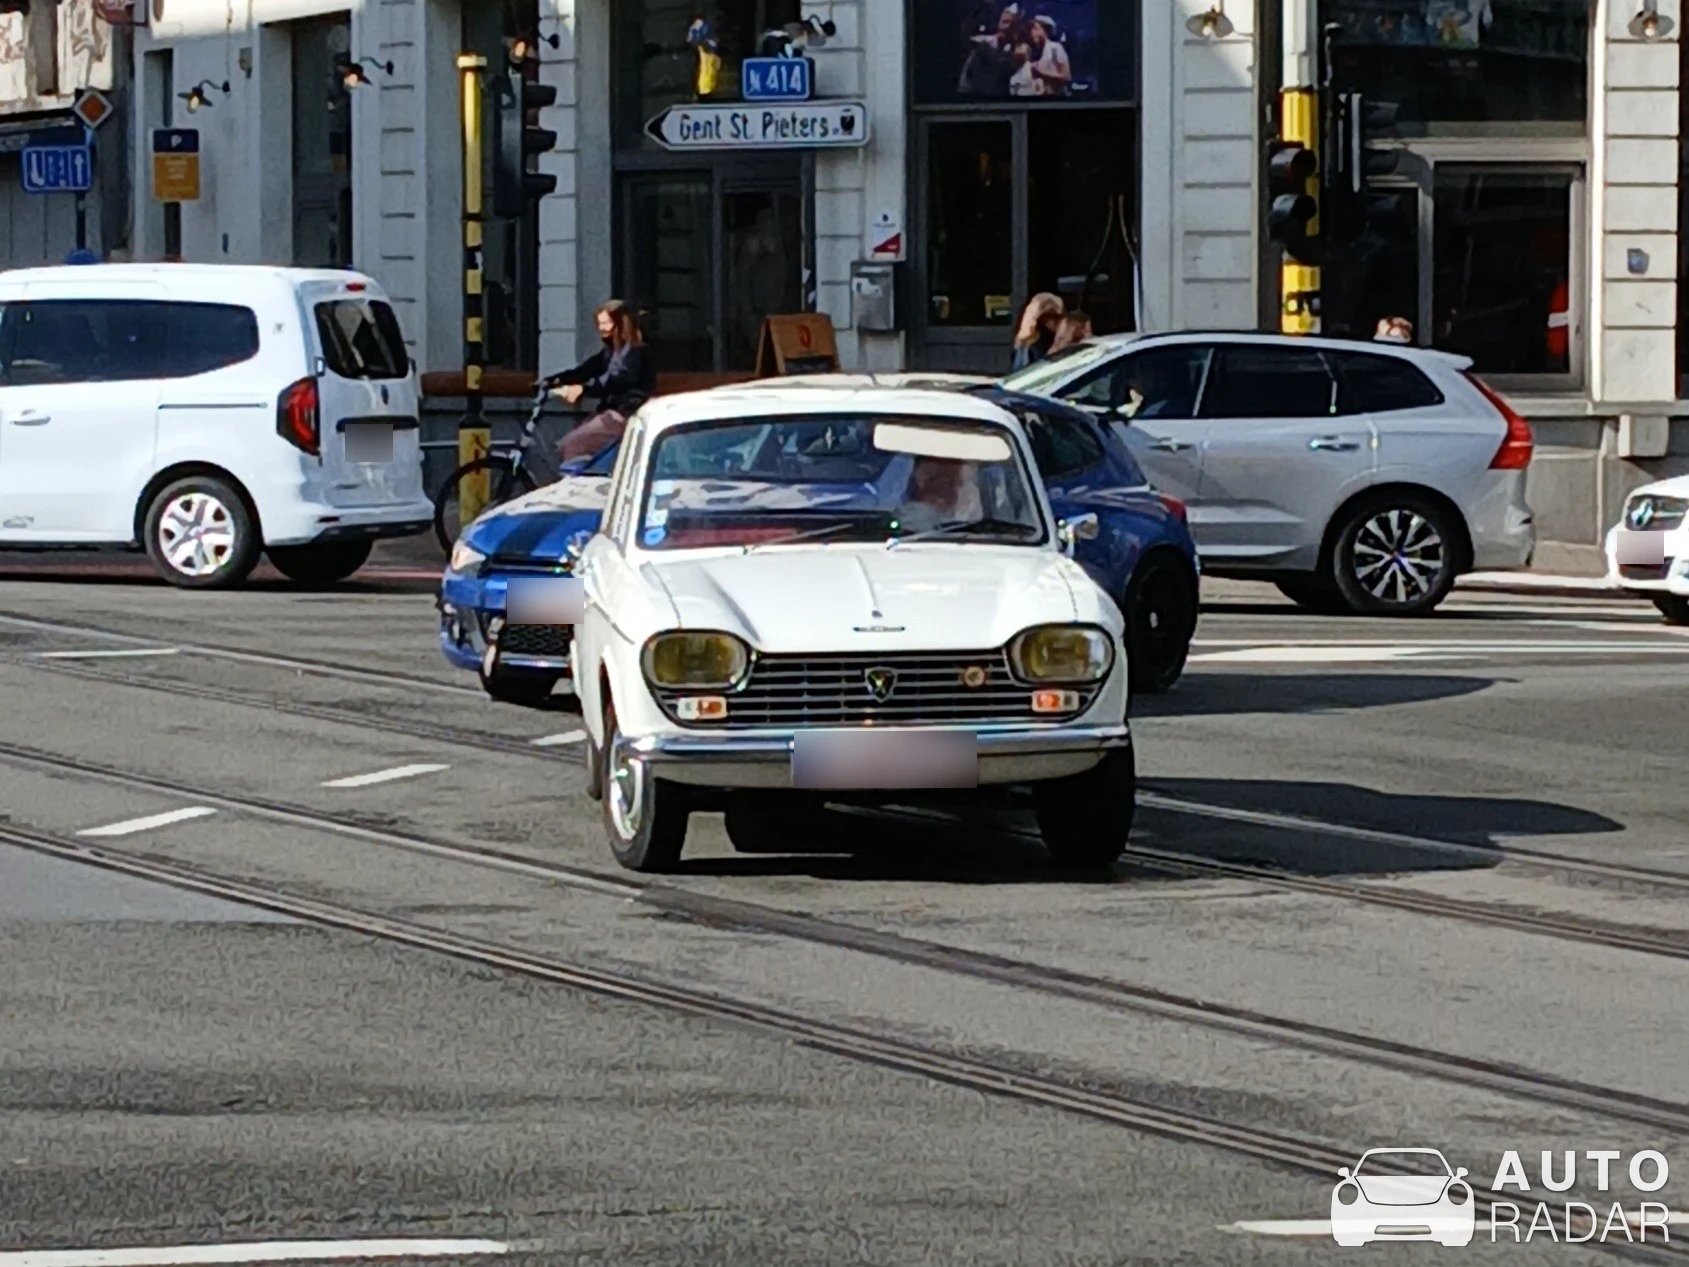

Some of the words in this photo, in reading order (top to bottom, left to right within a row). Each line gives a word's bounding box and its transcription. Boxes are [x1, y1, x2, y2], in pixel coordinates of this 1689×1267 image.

[765, 63, 802, 93] 414
[679, 113, 721, 141] Gent
[762, 111, 829, 139] Pieters
